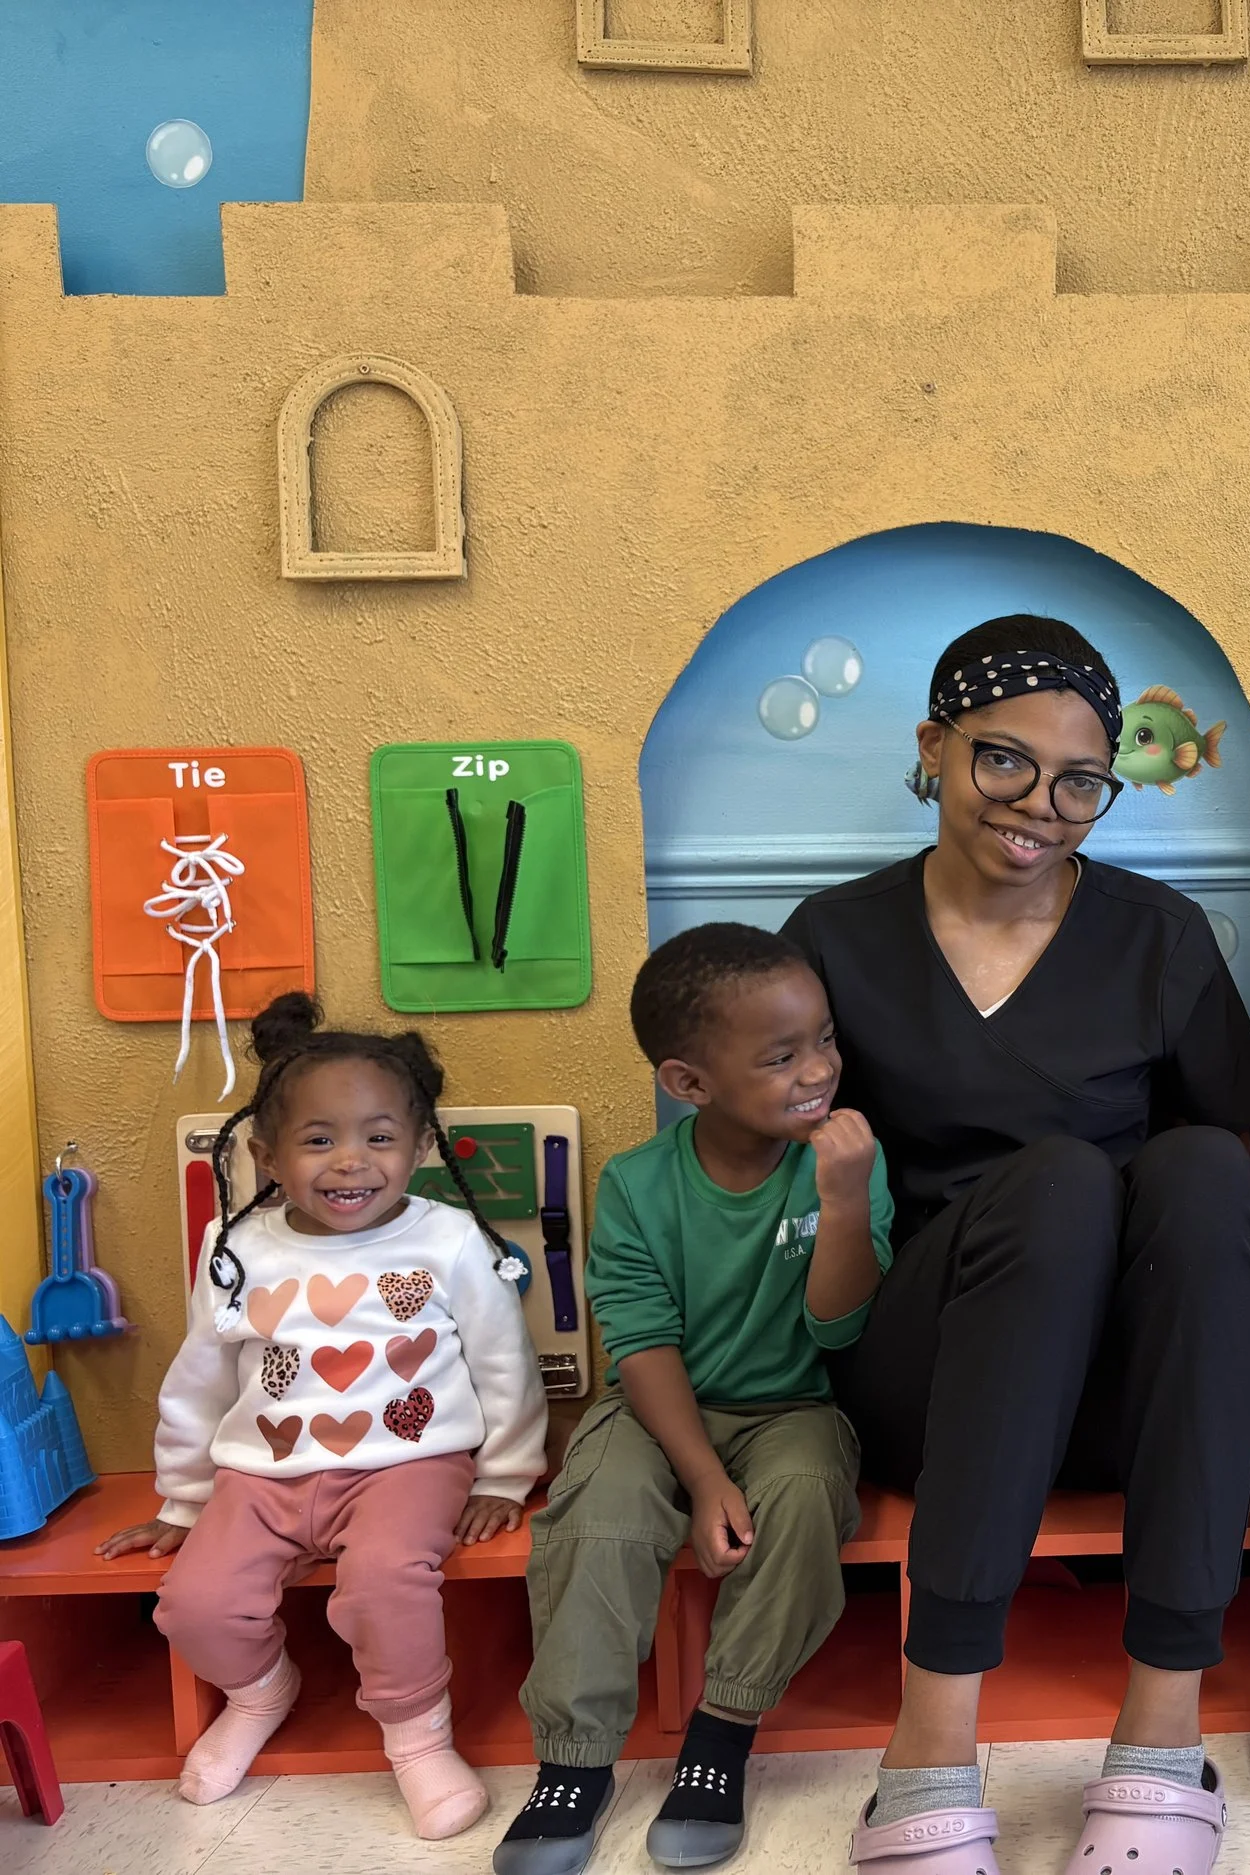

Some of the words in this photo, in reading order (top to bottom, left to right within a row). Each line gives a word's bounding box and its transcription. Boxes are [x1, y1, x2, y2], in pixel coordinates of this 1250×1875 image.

[167, 760, 226, 789] Tie
[451, 754, 510, 782] Zip
[784, 1244, 807, 1260] U.S.A.
